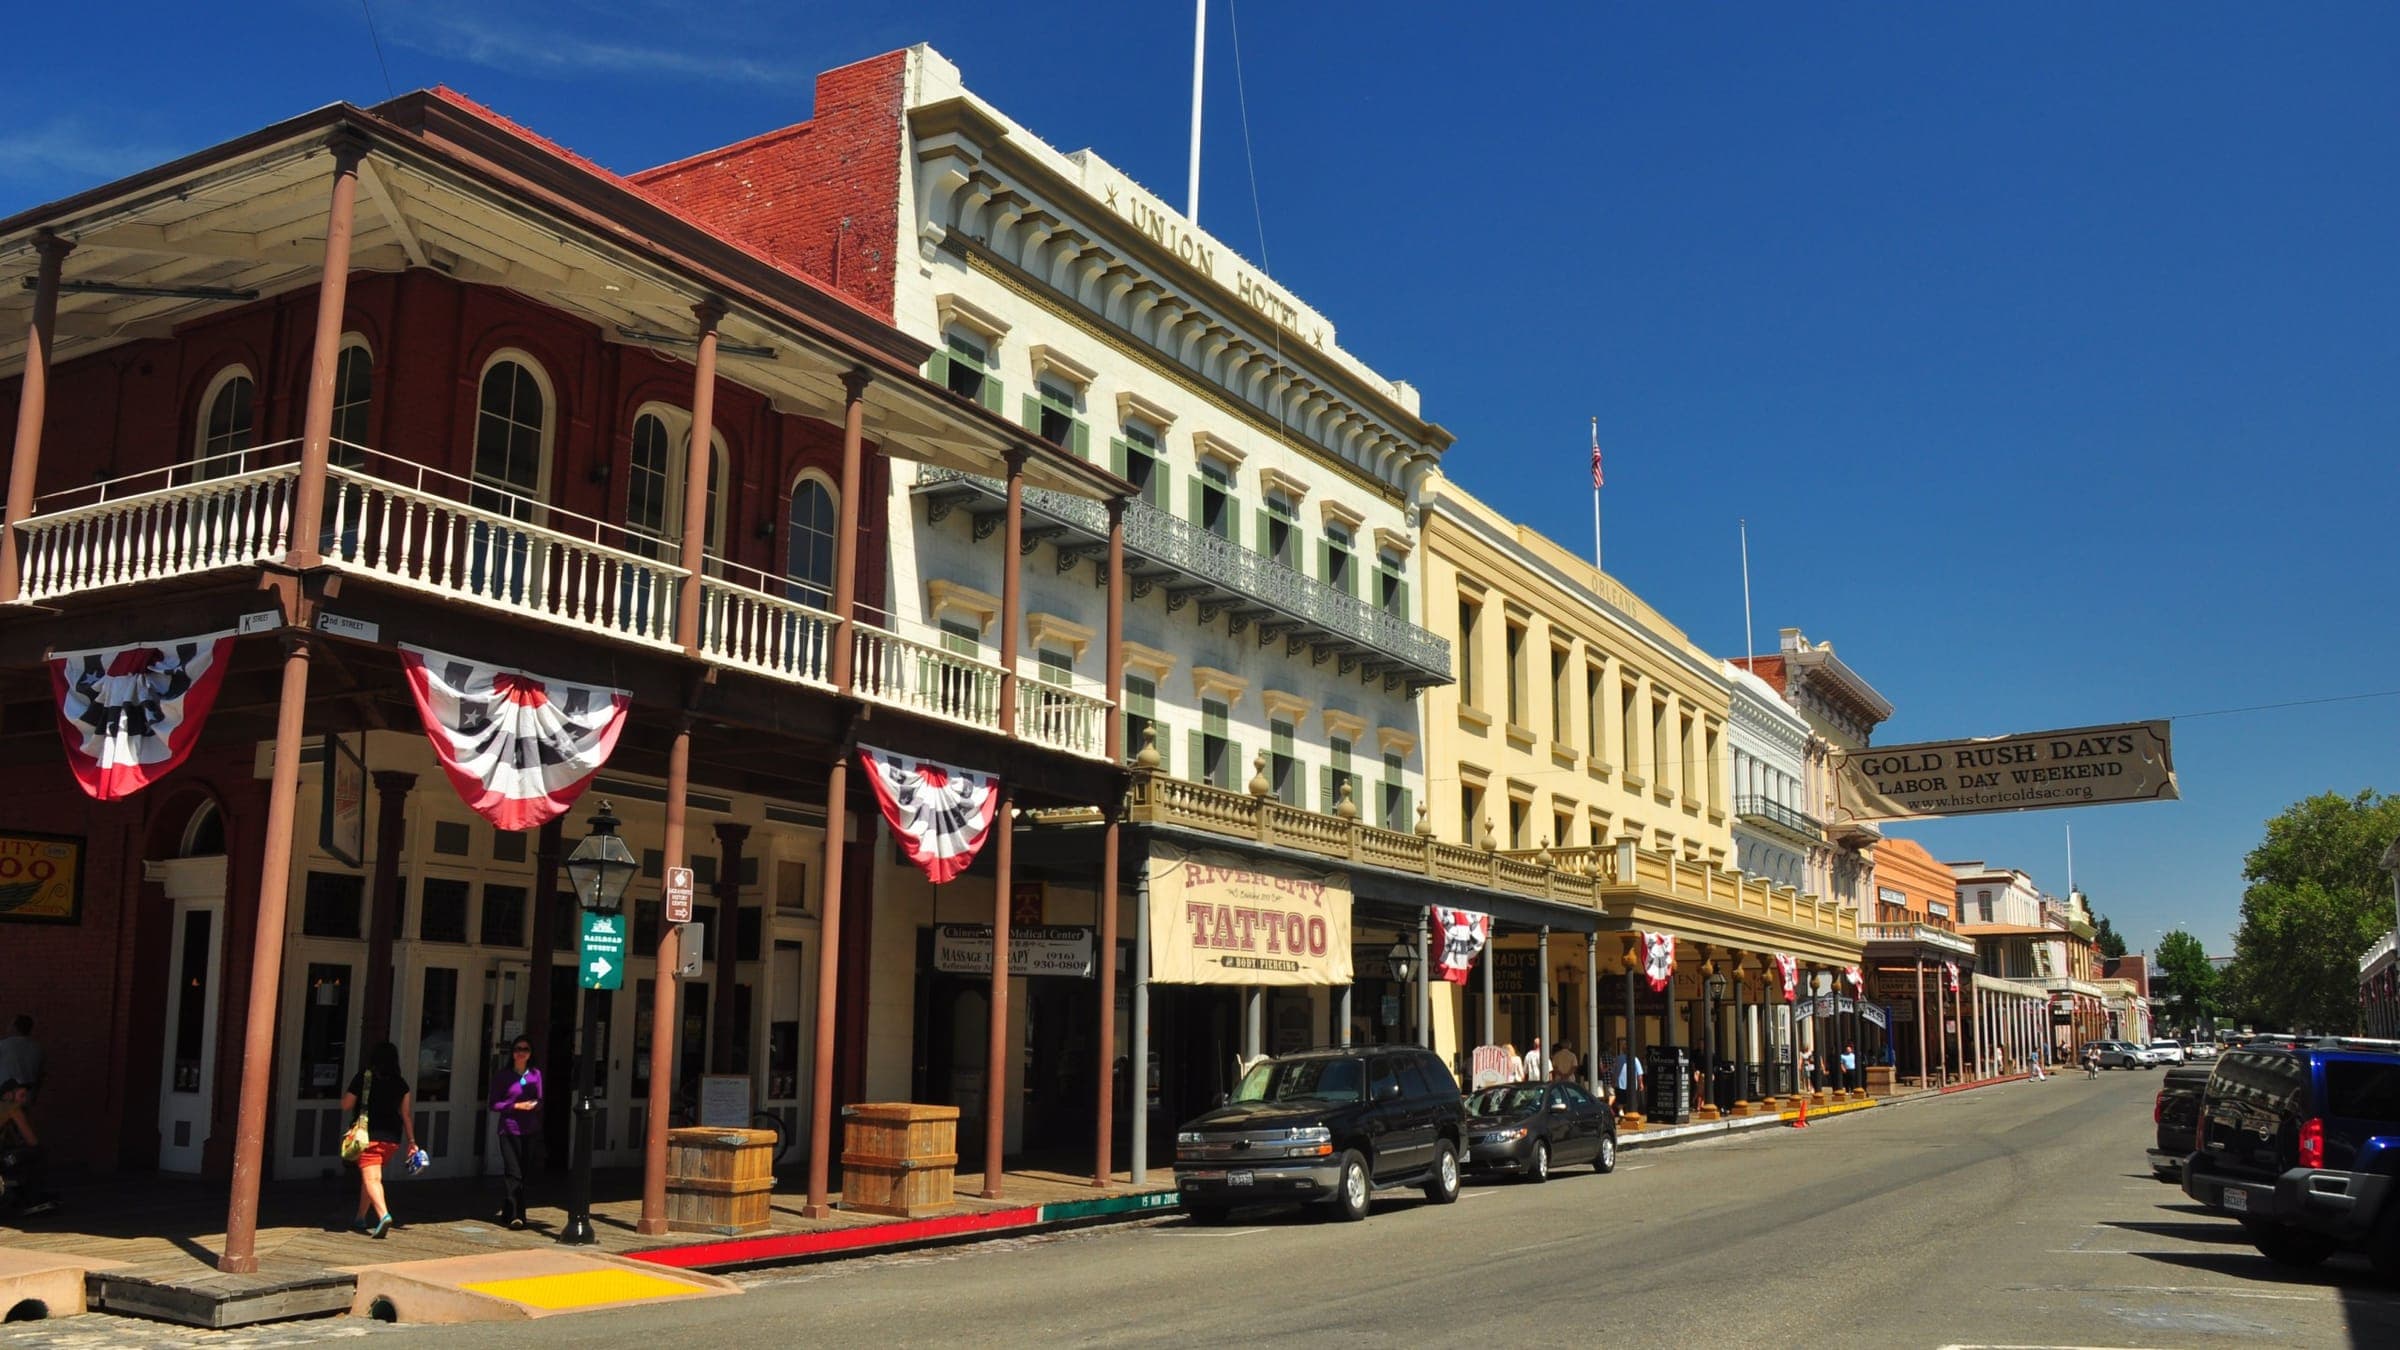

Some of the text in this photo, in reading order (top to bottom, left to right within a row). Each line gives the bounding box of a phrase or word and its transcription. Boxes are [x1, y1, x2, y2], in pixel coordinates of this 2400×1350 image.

[1130, 197, 1307, 342] UNION HOTEL
[1591, 574, 1638, 618] ORLEANS
[244, 614, 269, 632] K STREET
[340, 619, 364, 631] STREET
[1862, 735, 2134, 776] GOLD RUSH DAYS
[1879, 762, 2122, 796] LABOR DAY WEEKEND
[1908, 785, 2092, 810] www.historicoldsac.org
[1185, 863, 1325, 907] RIVER CITY
[1050, 928, 1082, 940] Center
[1186, 901, 1327, 957] TATTOO
[584, 935, 622, 944] RAILROAD
[587, 944, 617, 953] MUSEUM
[941, 949, 982, 961] MASSAGE
[1046, 952, 1075, 961] (916)
[1033, 960, 1086, 970] 930-0808
[1236, 957, 1256, 968] BODY
[1260, 959, 1296, 971] PIERCING
[1141, 1196, 1148, 1207] 15
[1164, 1193, 1179, 1205] ZONE
